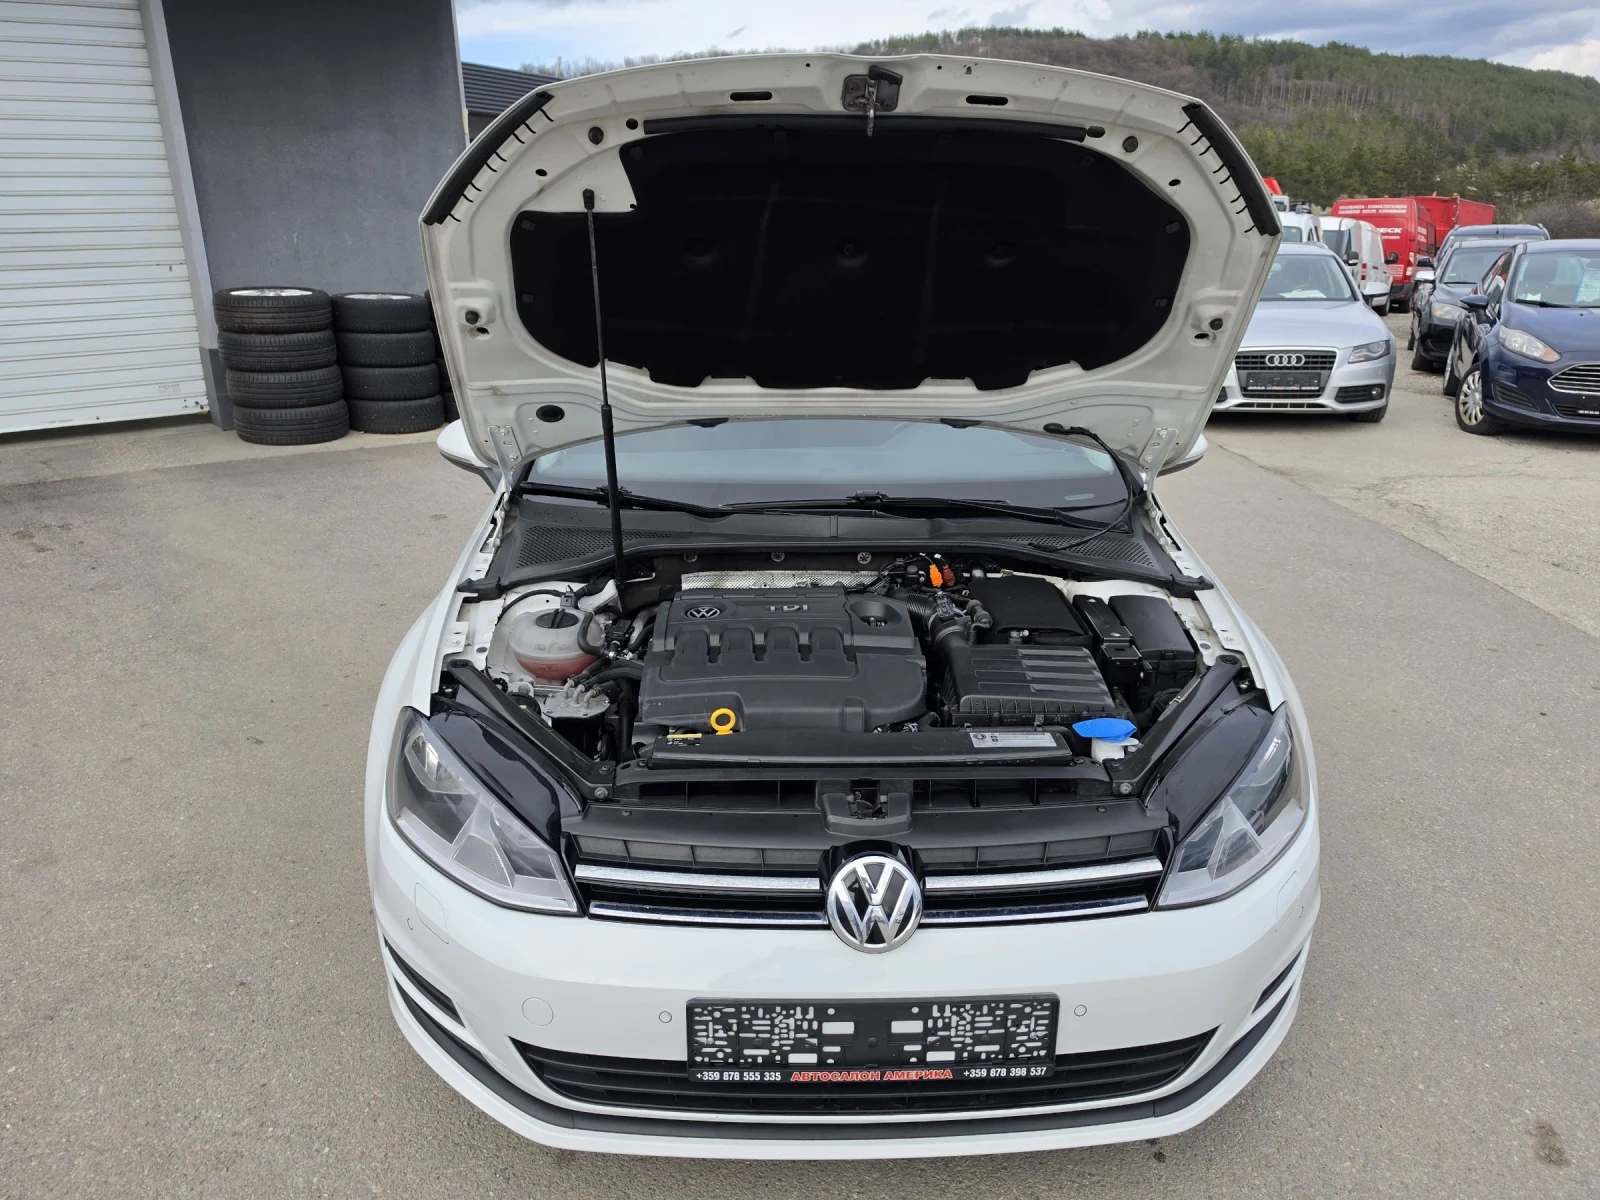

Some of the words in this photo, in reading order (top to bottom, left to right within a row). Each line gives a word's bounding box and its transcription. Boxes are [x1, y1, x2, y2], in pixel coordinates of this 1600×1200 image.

[766, 604, 808, 613] TDI
[696, 1071, 720, 1081] +359
[722, 1071, 740, 1081] 878
[743, 1071, 761, 1081] 555
[763, 1071, 782, 1081] 335
[790, 1070, 881, 1082] АВТОСАЛОН
[883, 1069, 954, 1081] АМЕРИКА
[963, 1068, 987, 1078] +359
[989, 1068, 1007, 1077] 878
[1009, 1067, 1027, 1077] 398
[1029, 1066, 1048, 1076] 537
